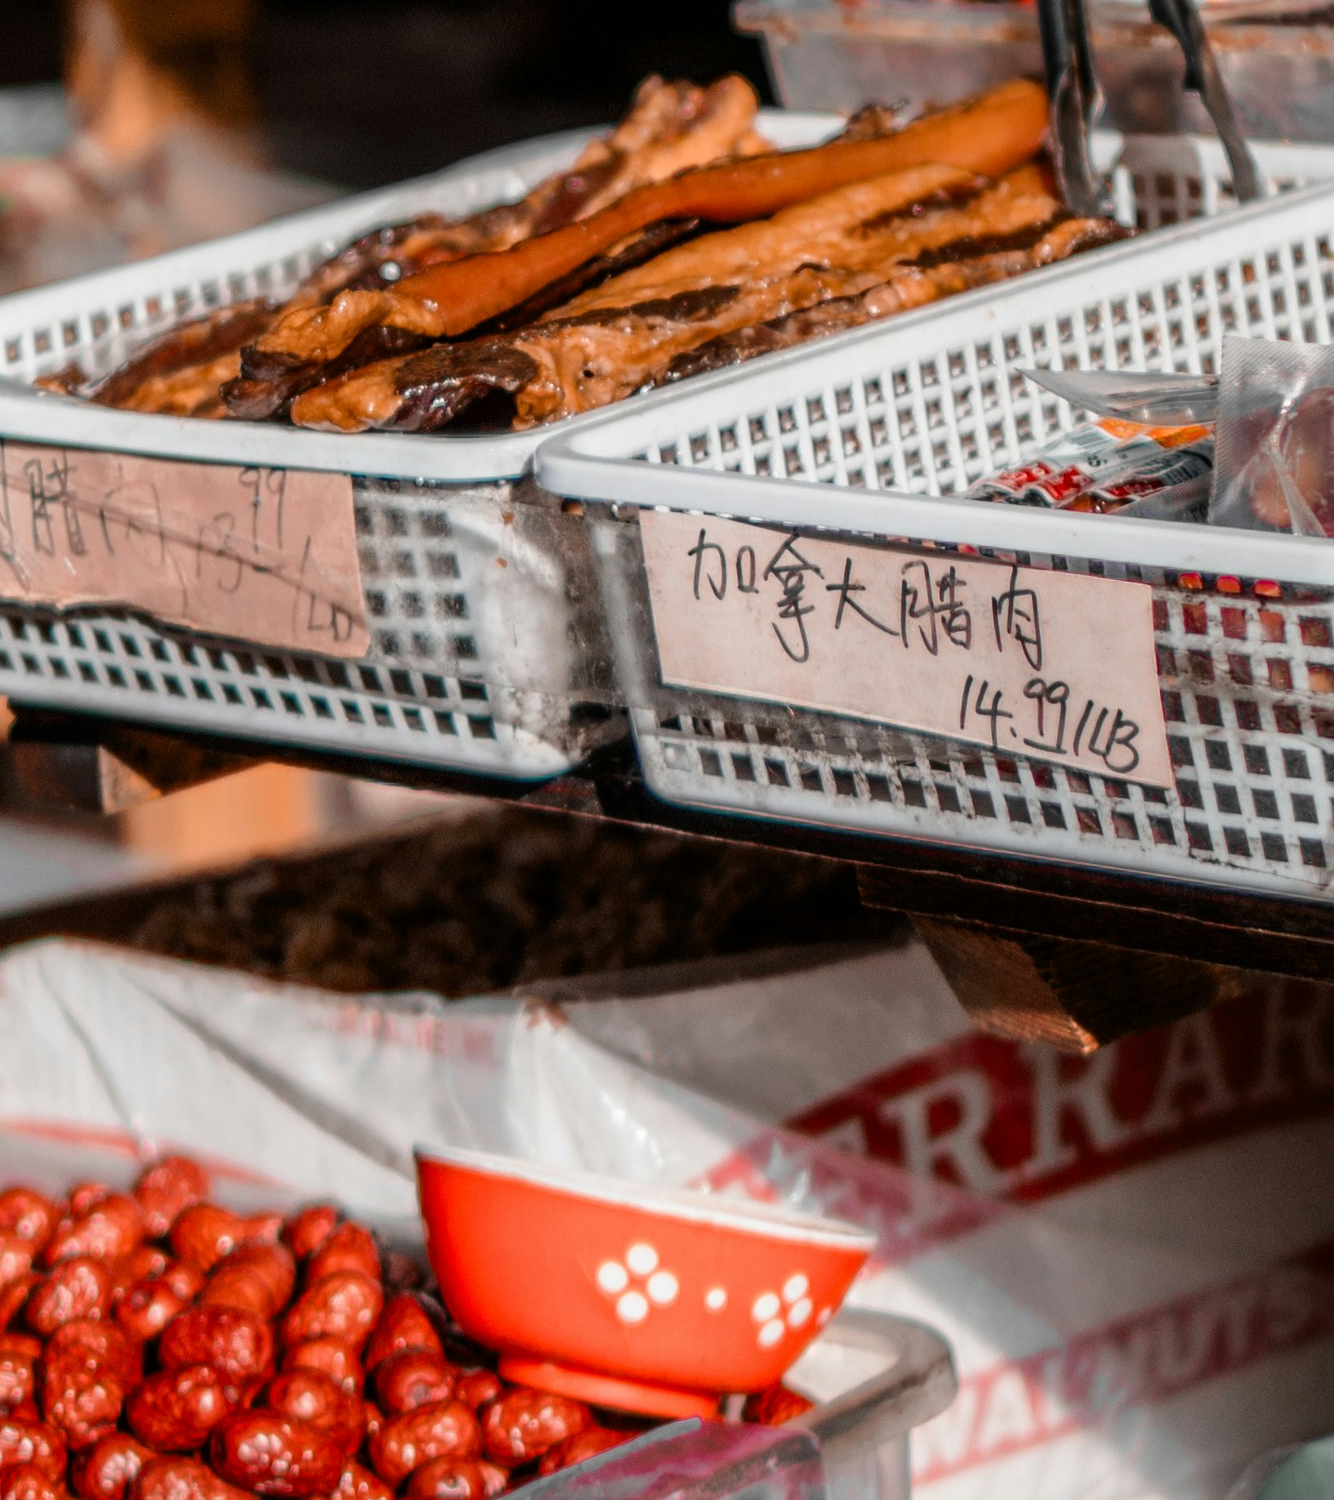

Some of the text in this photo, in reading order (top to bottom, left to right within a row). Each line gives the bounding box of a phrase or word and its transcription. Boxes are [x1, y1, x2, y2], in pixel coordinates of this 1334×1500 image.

[687, 527, 1043, 671] 加拿大腊肉
